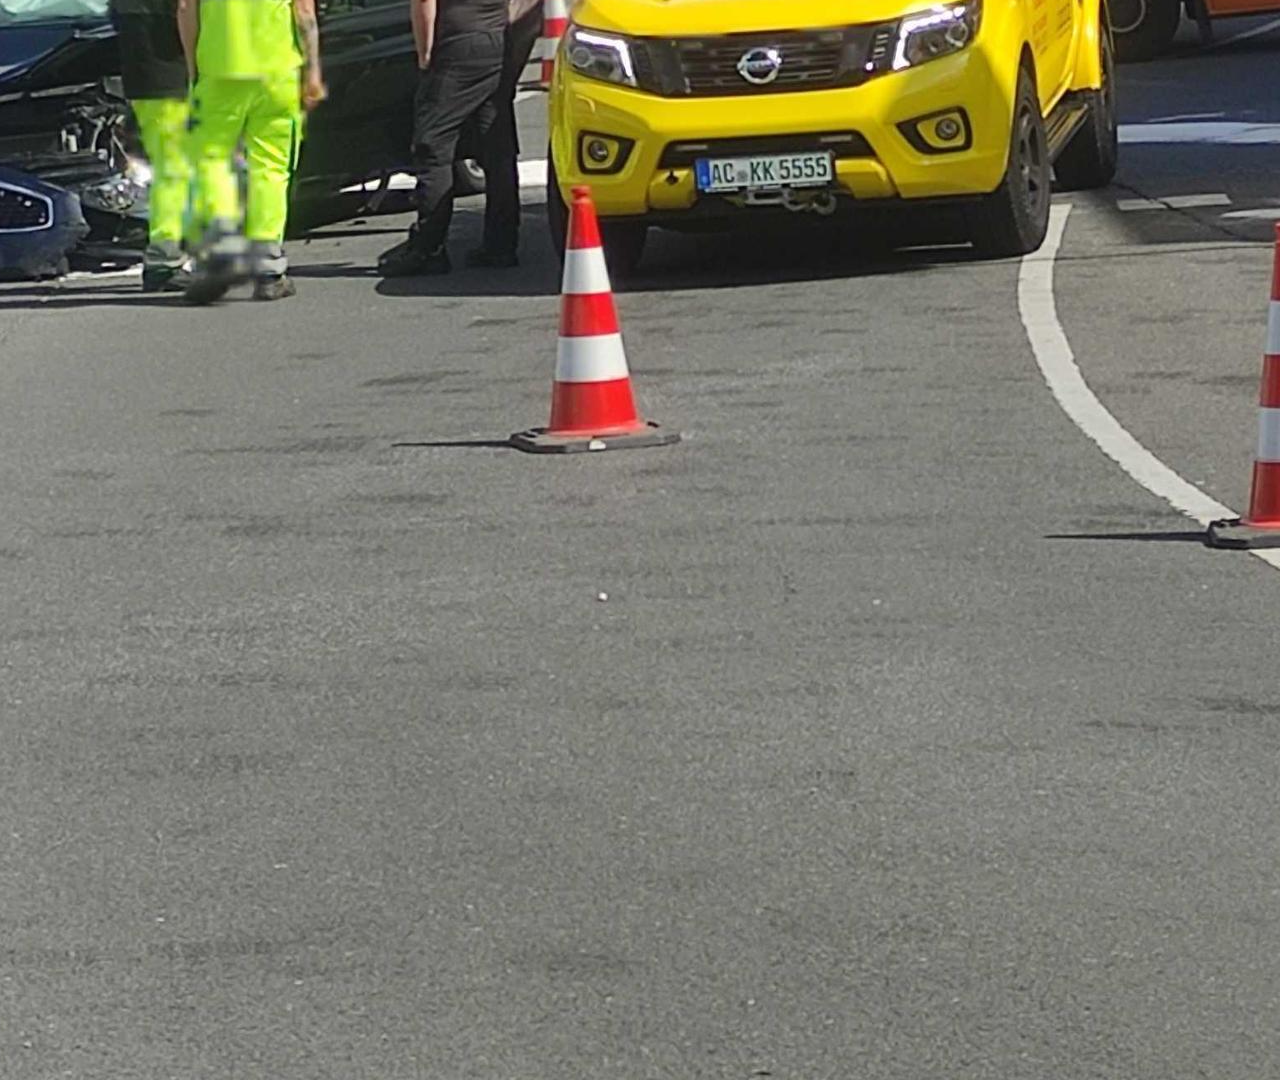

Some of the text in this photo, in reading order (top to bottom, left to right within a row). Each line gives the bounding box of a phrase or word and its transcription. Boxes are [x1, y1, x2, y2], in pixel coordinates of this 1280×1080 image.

[712, 156, 827, 183] AC KK 5555
